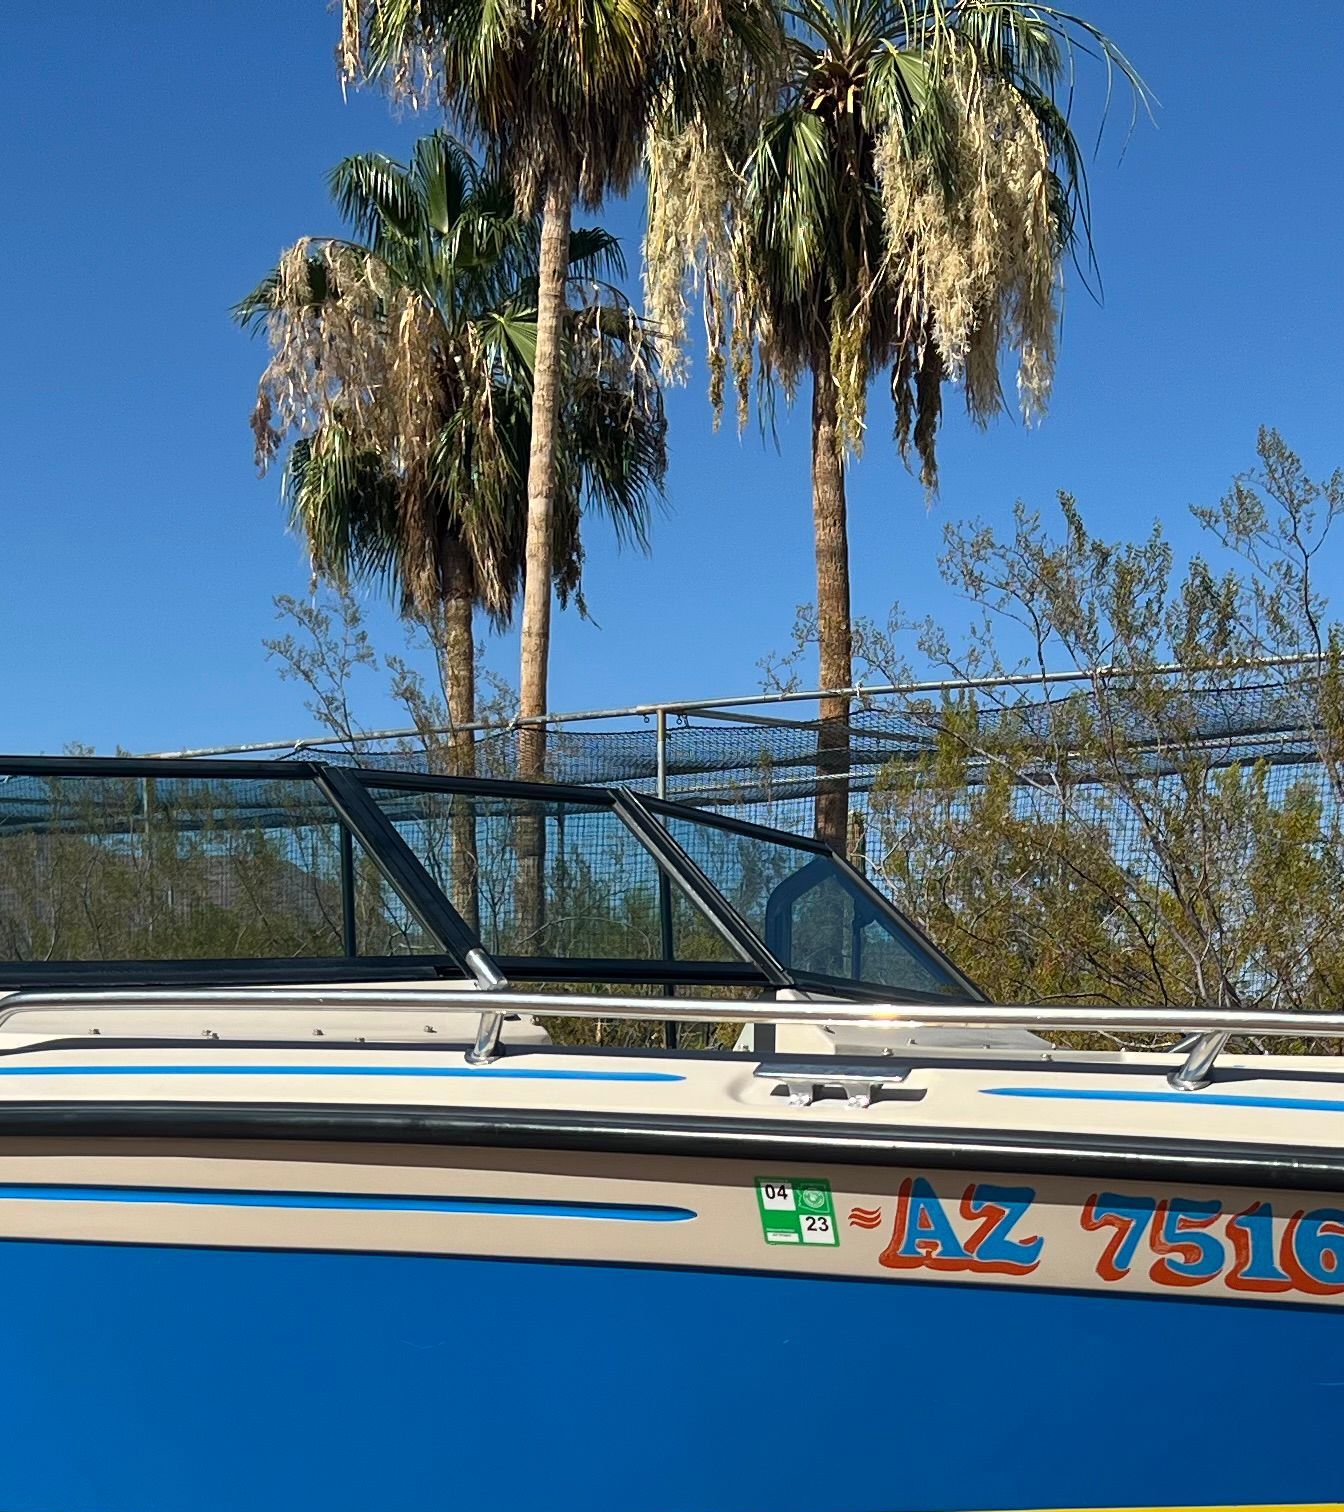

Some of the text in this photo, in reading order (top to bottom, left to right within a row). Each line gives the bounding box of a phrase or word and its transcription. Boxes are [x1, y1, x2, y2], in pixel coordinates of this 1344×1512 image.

[764, 1184, 788, 1200] 04
[805, 1216, 829, 1232] 23
[879, 1176, 1044, 1276] AZ
